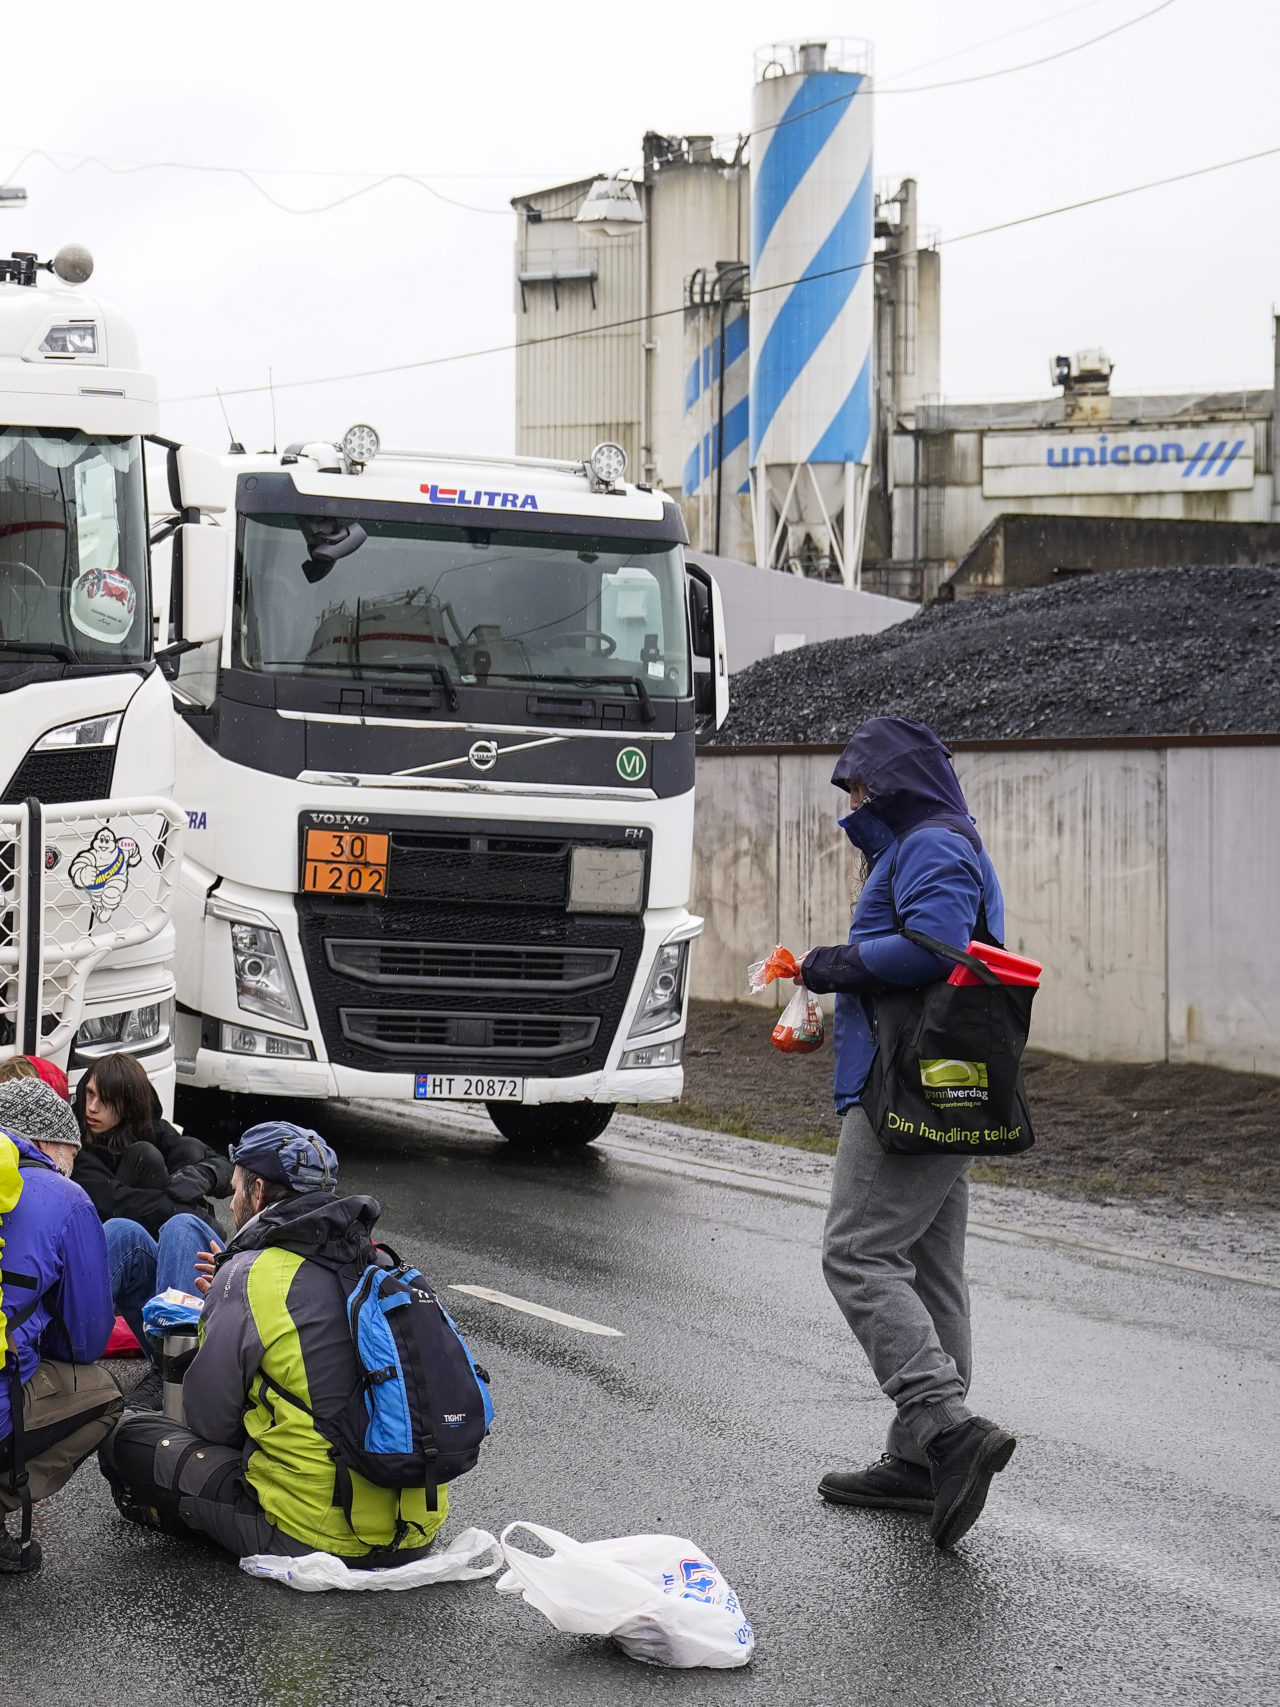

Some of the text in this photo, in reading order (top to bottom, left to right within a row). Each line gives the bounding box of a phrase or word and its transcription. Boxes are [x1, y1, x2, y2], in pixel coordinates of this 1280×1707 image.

[1047, 435, 1185, 468] unicon
[457, 490, 539, 509] LITRA
[623, 755, 640, 773] VI
[309, 813, 370, 825] VOLVO
[625, 828, 643, 839] FH
[330, 834, 365, 859] 30
[95, 854, 124, 885] MICHELIN
[312, 865, 383, 893] 1202
[432, 1078, 455, 1095] HT
[463, 1079, 518, 1097] 20872
[888, 1112, 1022, 1144] Din handling teller
